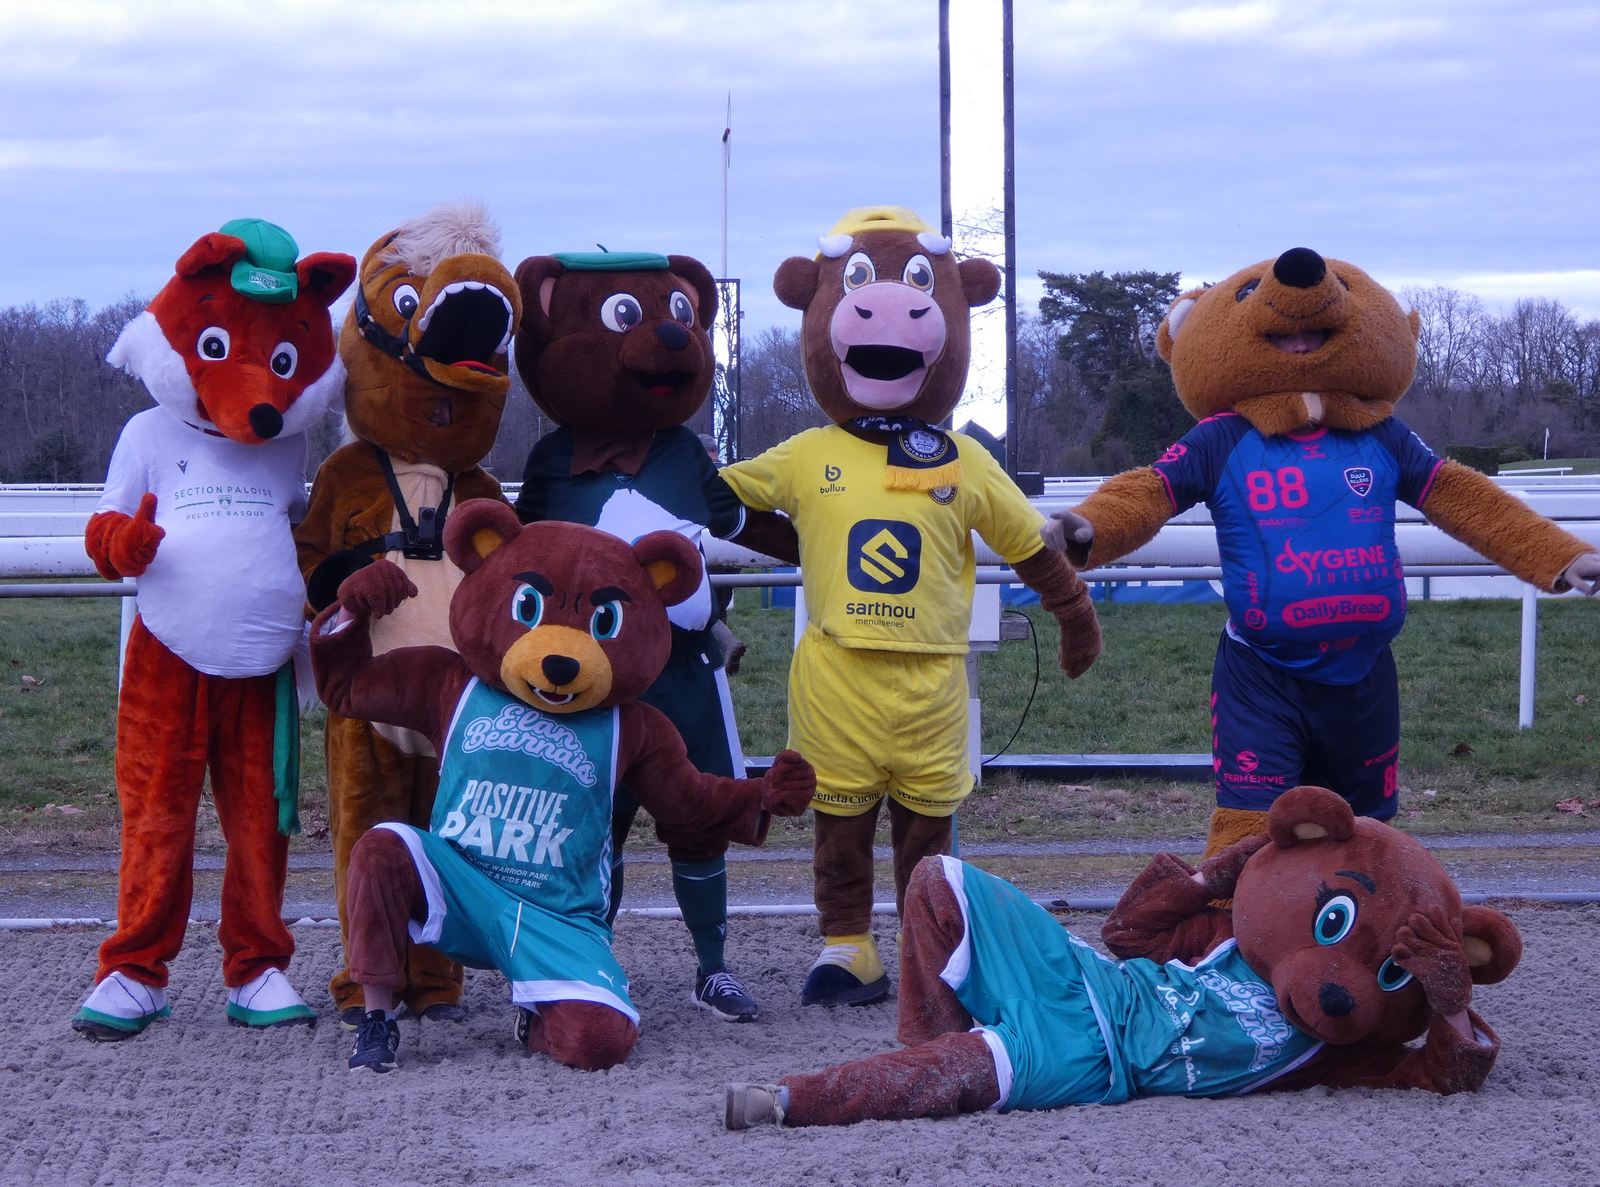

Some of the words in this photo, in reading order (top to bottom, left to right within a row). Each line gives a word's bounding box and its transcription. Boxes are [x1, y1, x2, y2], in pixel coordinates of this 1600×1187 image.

[174, 486, 223, 500] SECTION
[227, 486, 273, 498] PALOISE
[820, 483, 846, 494] bullux
[1246, 466, 1309, 512] 88
[186, 511, 221, 520] PELOTE
[226, 510, 265, 518] BASQUE
[846, 602, 916, 619] sarthou
[1292, 600, 1386, 621] DailyBread
[461, 780, 569, 828] POSITIVE
[849, 791, 882, 803] Cucine
[438, 811, 575, 868] PARK
[492, 865, 528, 877] WARRIOR
[528, 872, 549, 881] PARK
[500, 876, 520, 884] KIDS
[521, 880, 543, 889] PARK
